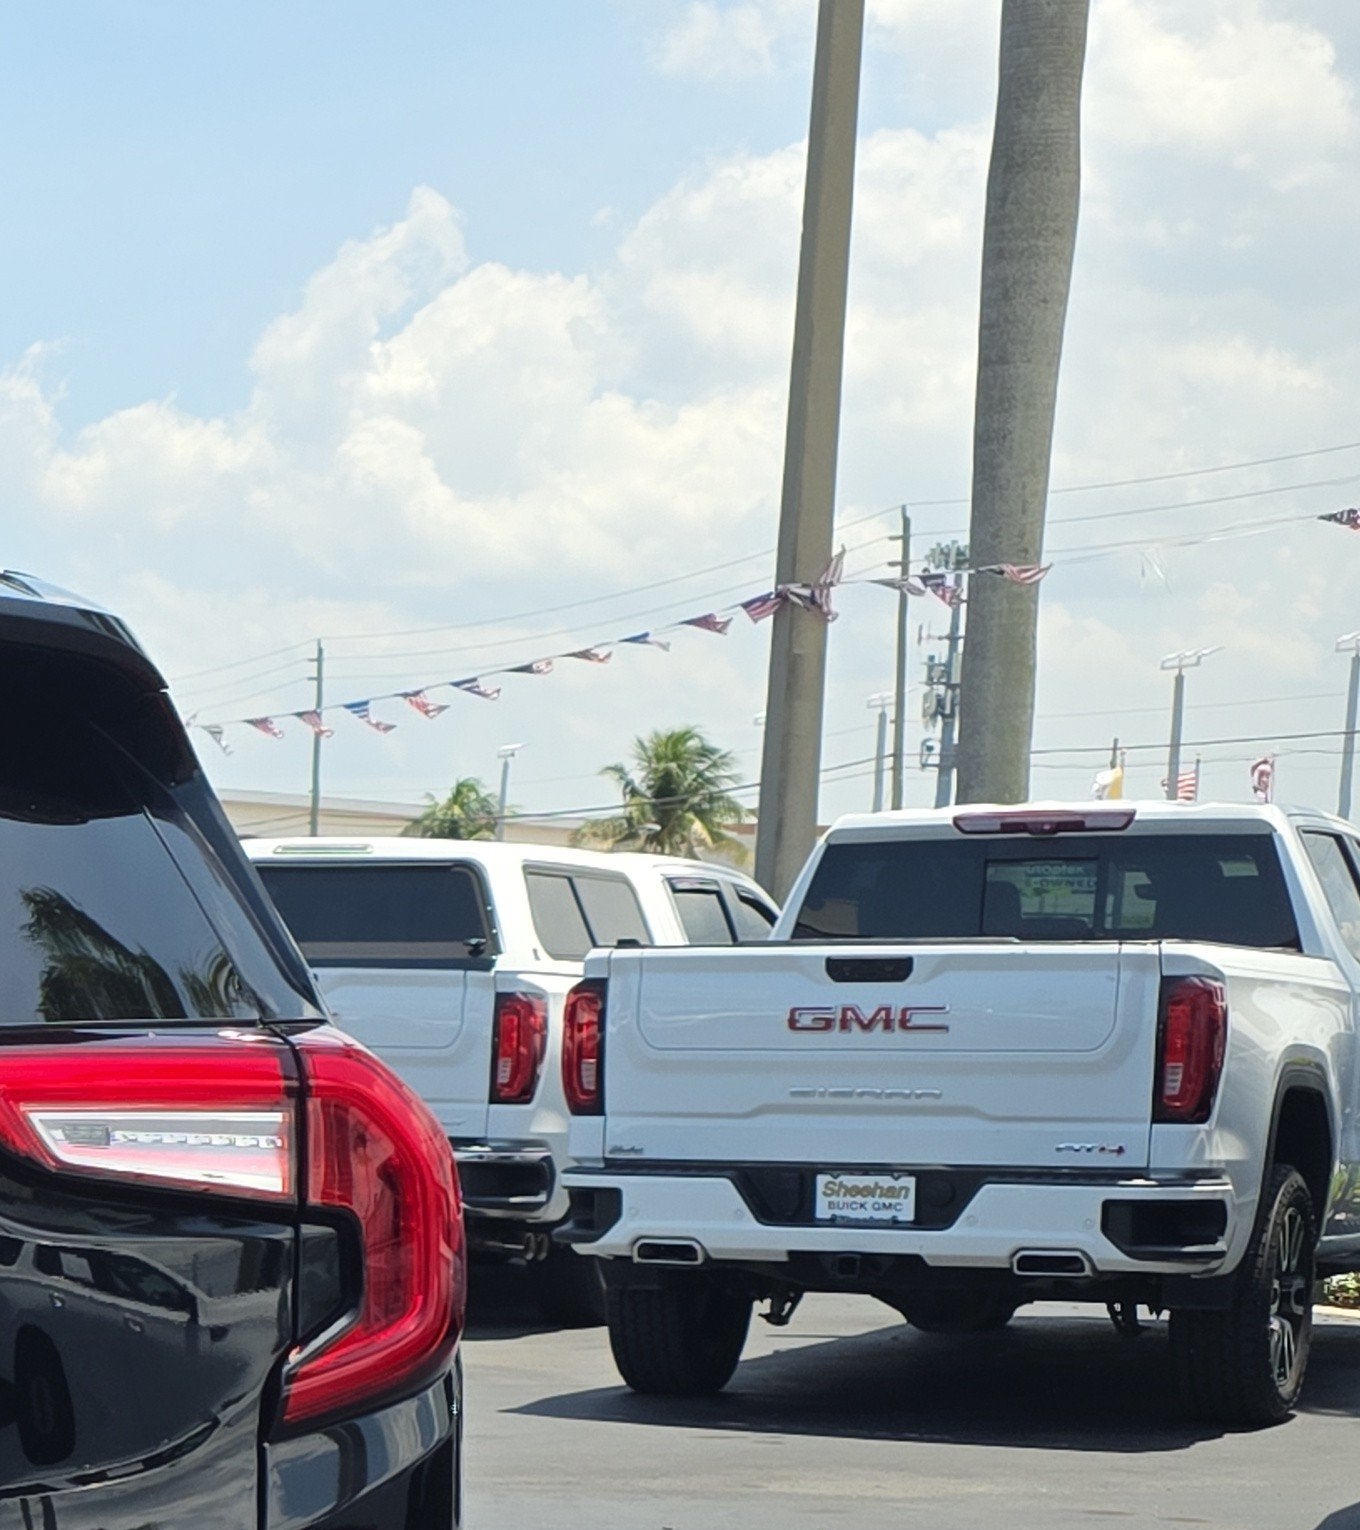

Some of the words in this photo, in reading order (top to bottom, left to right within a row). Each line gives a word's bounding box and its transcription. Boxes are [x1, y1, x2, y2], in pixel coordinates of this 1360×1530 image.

[787, 1004, 950, 1033] GMC
[822, 1181, 911, 1199] Sheehan
[828, 1201, 867, 1211] BUICK
[872, 1202, 903, 1212] GMC
